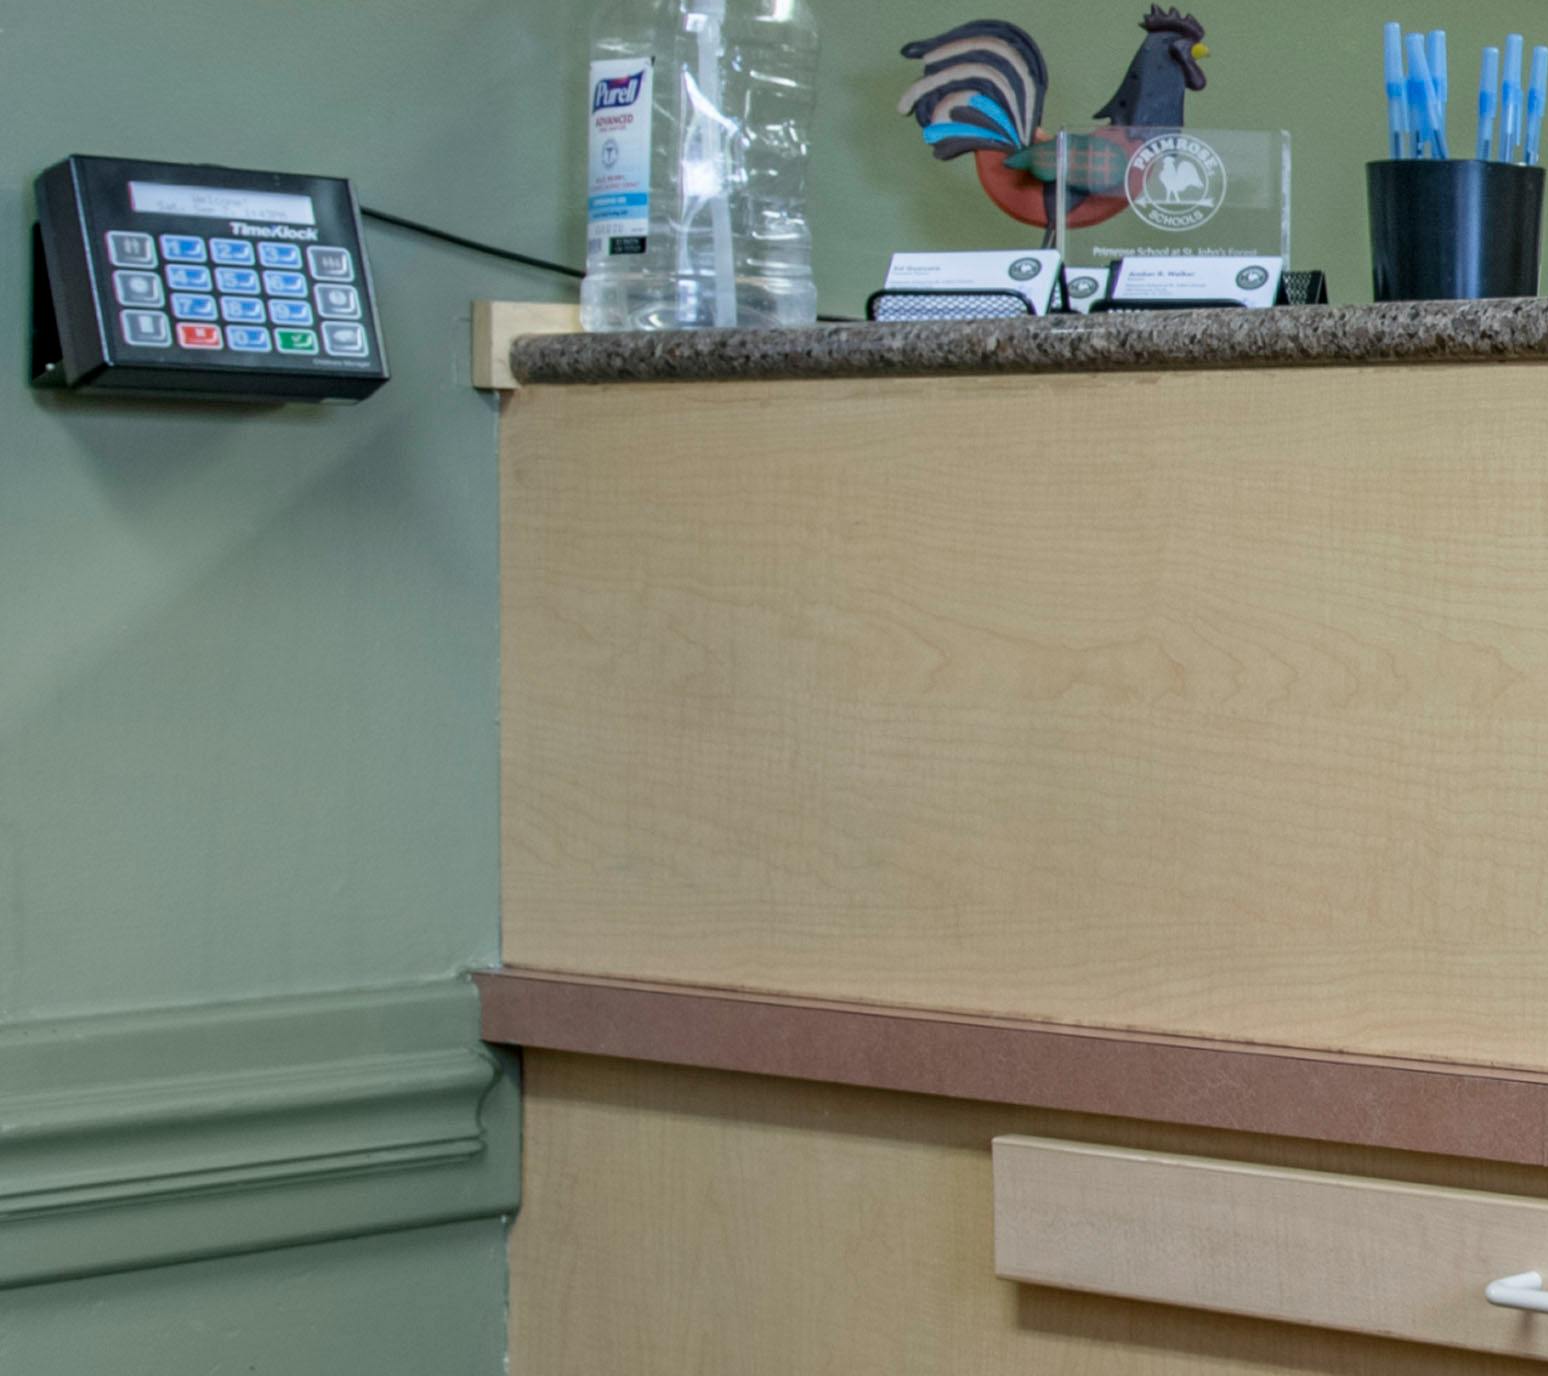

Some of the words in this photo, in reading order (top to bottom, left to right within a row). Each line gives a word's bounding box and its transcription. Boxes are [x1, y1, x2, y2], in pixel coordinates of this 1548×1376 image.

[1132, 138, 1218, 173] PRIMROSE
[1149, 210, 1203, 225] SCHOOLS
[1092, 247, 1135, 256] Primrose
[1137, 247, 1169, 256] School
[1171, 248, 1180, 256] at
